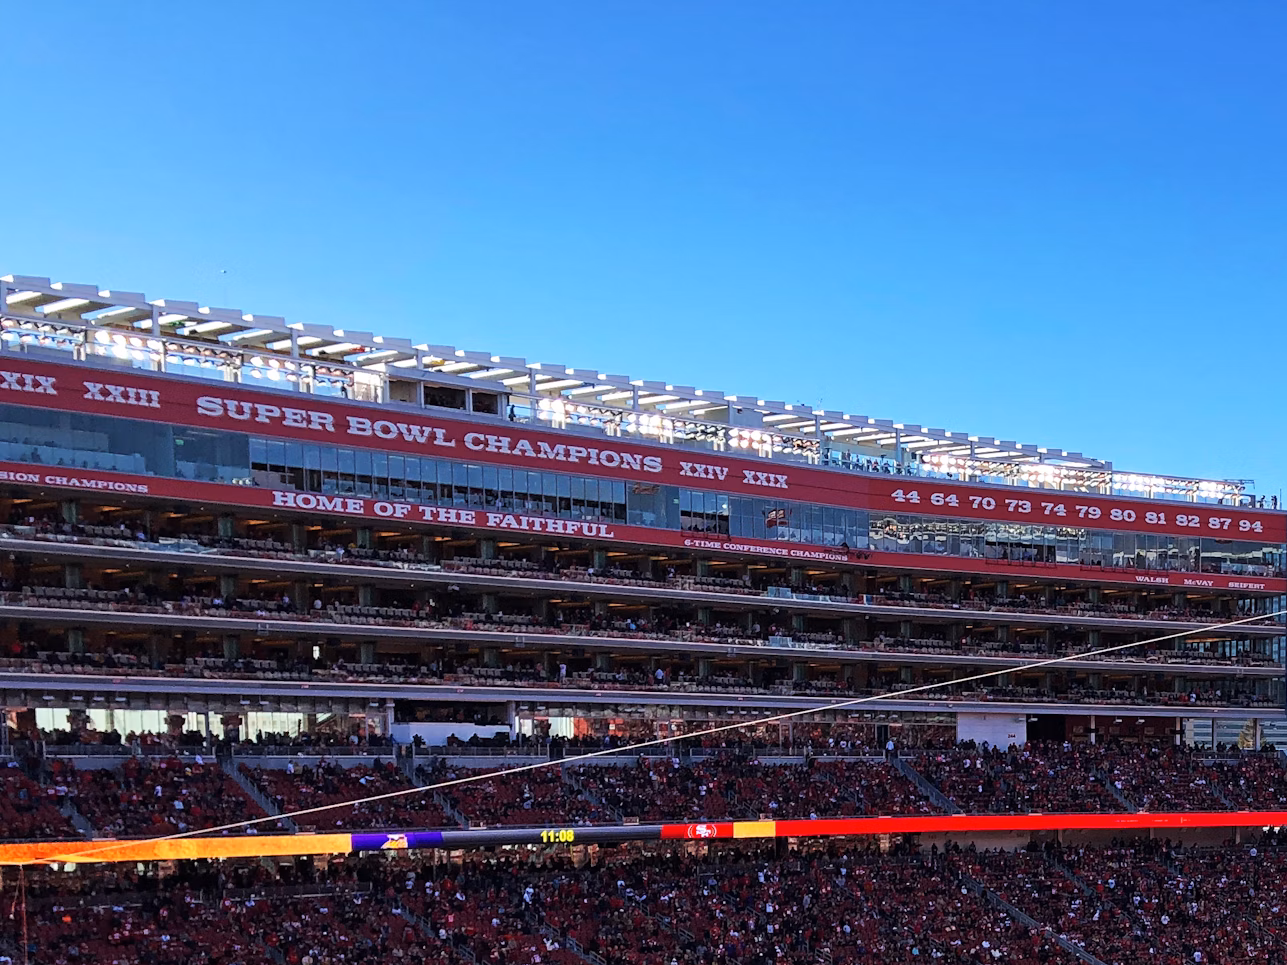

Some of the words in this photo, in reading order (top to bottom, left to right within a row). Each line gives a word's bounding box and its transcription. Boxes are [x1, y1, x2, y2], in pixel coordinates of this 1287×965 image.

[0, 370, 57, 396] XIX
[83, 381, 161, 408] XXIII
[196, 396, 335, 433] SUPER
[346, 415, 457, 448] BOWL
[464, 431, 663, 474] CHAMPIONS
[679, 461, 729, 482] XXIV
[742, 468, 789, 489] XXIX
[44, 475, 149, 494] CHAMPIONS
[272, 491, 365, 515] HOME
[373, 501, 412, 519] OF
[418, 504, 476, 526] THE
[486, 512, 615, 539] FAITHFUL
[890, 488, 920, 503] 44
[930, 492, 959, 507] 64
[968, 495, 996, 510] 70
[1004, 498, 1033, 514] 73
[1040, 501, 1068, 517] 74
[1074, 504, 1102, 520] 79
[1109, 507, 1137, 523] 80
[1144, 511, 1168, 526] 81
[1175, 514, 1201, 528] 82
[1207, 515, 1232, 531] 87
[1238, 518, 1264, 534] 94
[683, 537, 722, 551] 6-TIME
[723, 541, 789, 557] CONFERENCE
[1135, 575, 1169, 585] WALSH
[1183, 578, 1214, 588] McVAY
[1228, 581, 1266, 591] SEIFERT
[540, 828, 576, 844] 11:08
